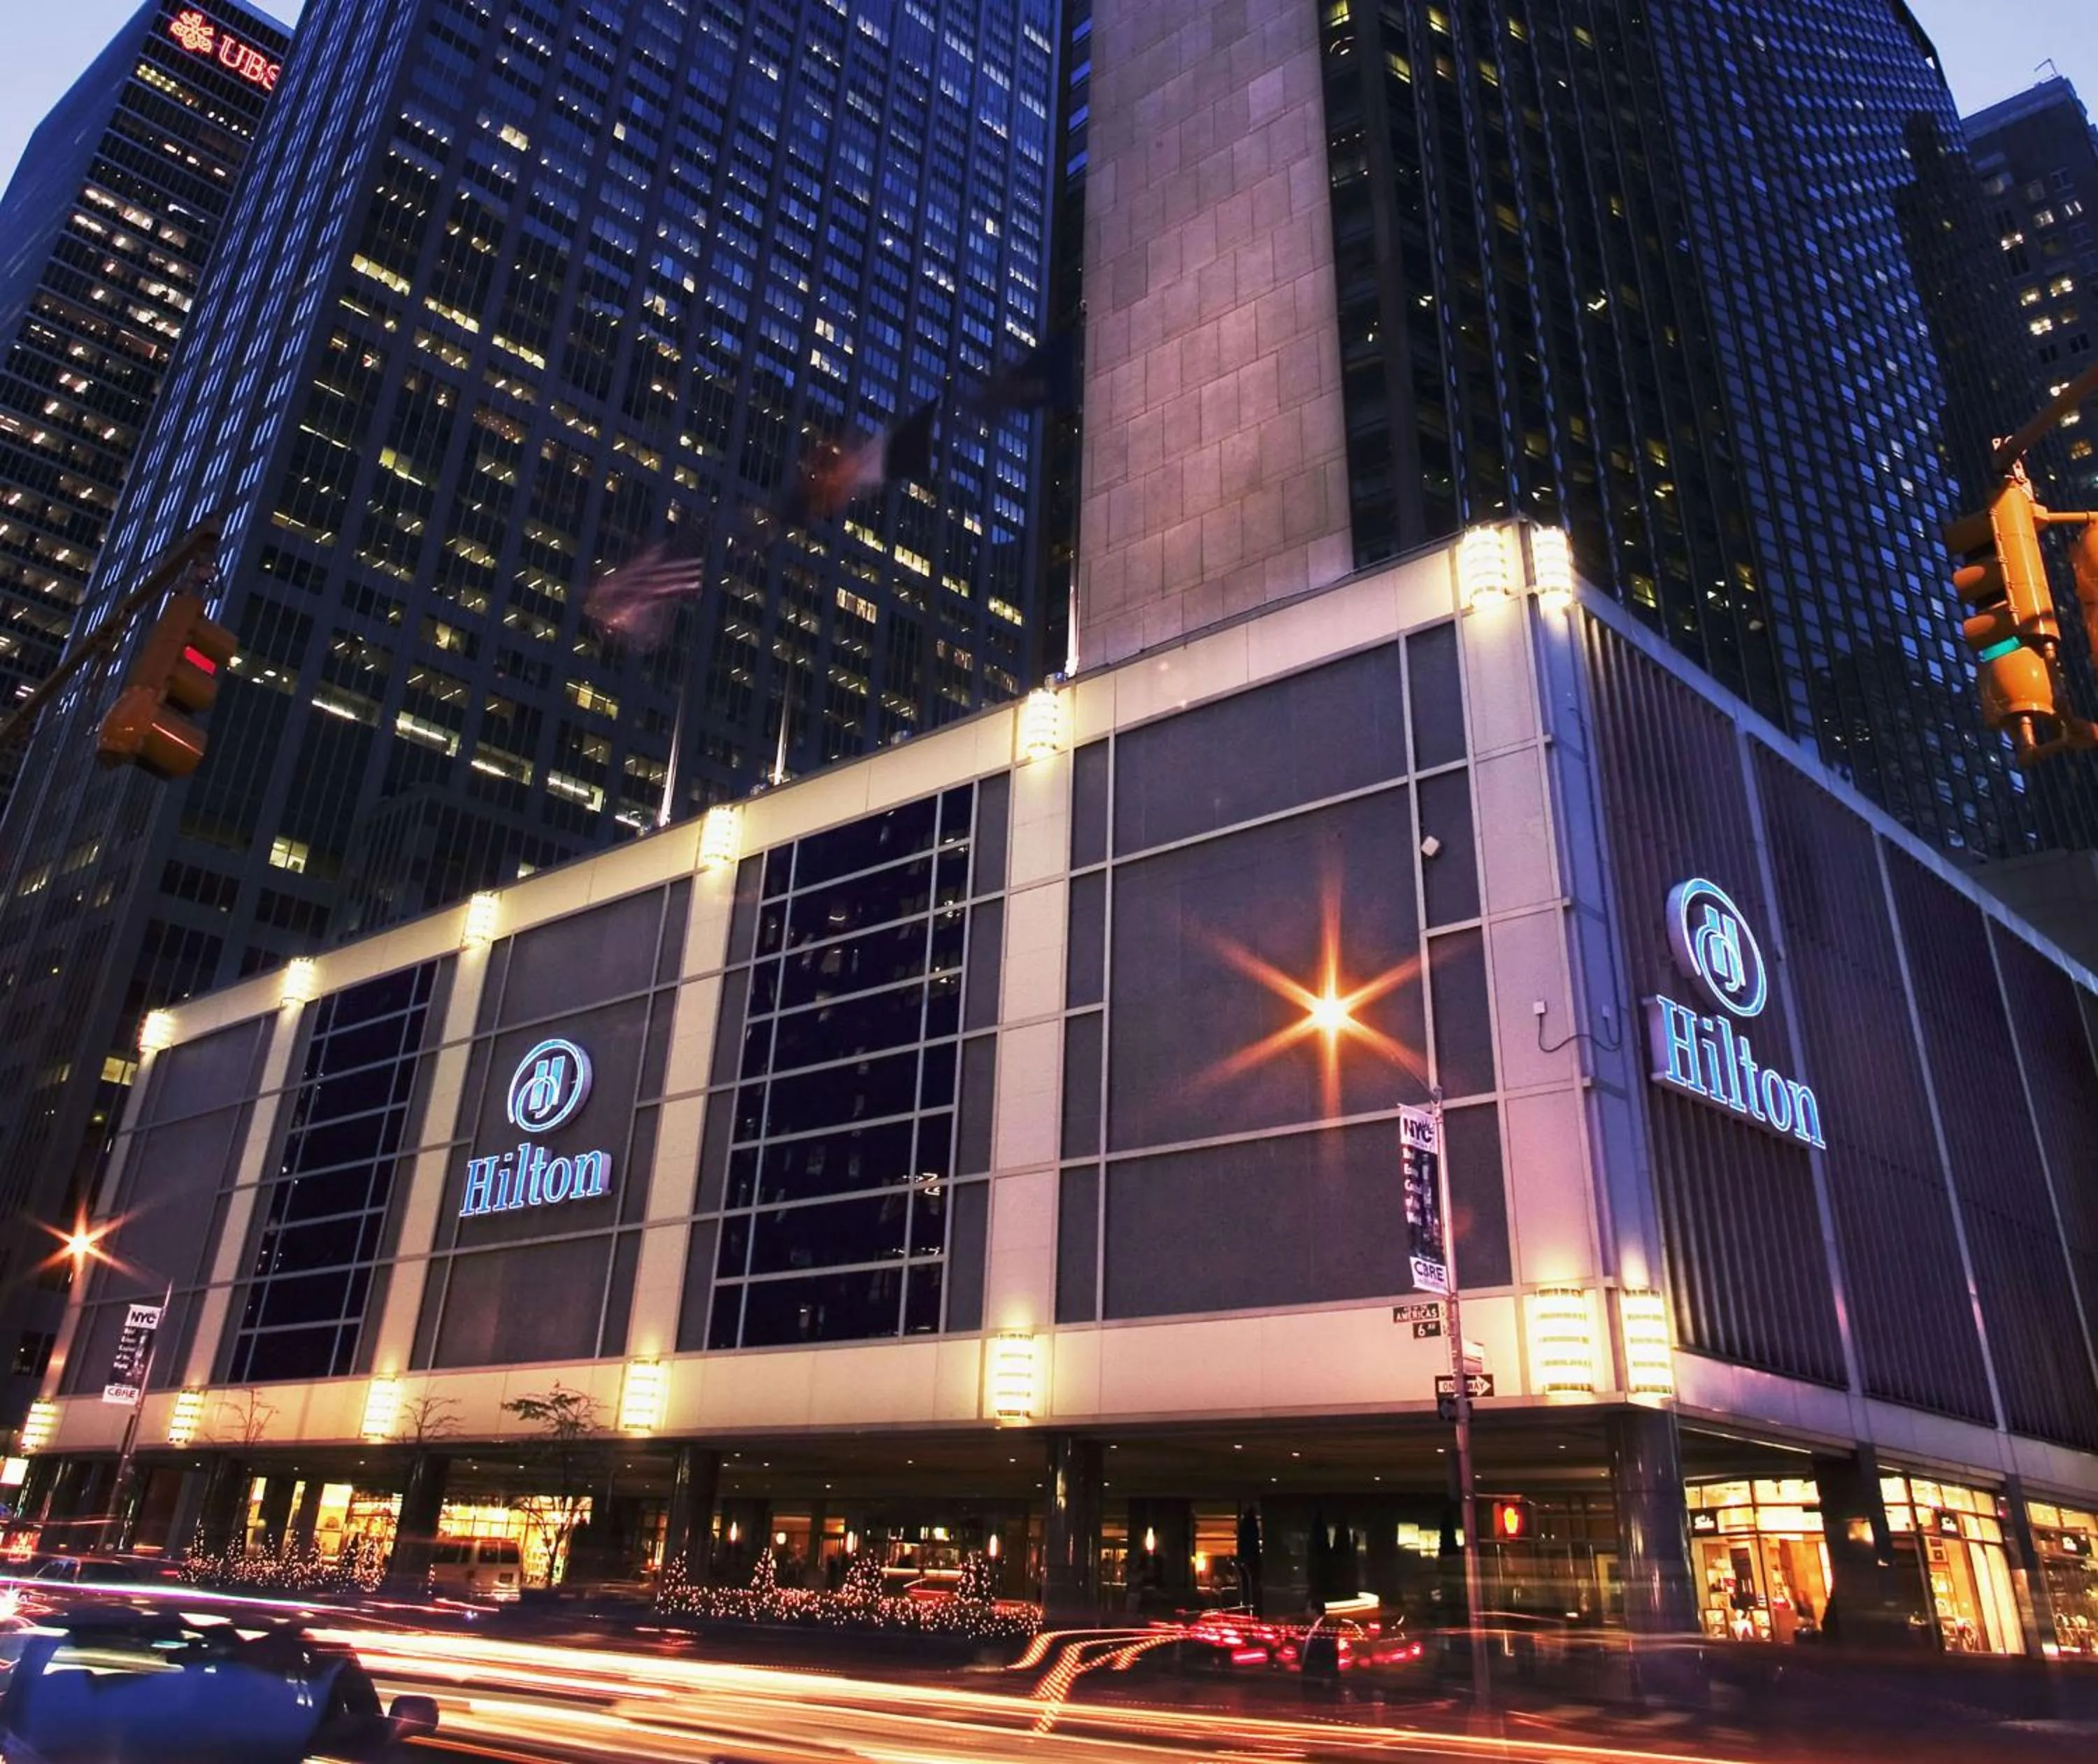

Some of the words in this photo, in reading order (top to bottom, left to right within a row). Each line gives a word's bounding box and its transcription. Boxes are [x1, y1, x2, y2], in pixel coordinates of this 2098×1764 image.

[219, 34, 280, 91] UBS
[1656, 994, 1827, 1150] Hilton
[1403, 1117, 1434, 1144] NYC
[459, 1142, 603, 1218] Hilton
[1414, 1260, 1444, 1282] CBRE
[131, 1311, 157, 1324] NYC
[1418, 1324, 1426, 1337] 6
